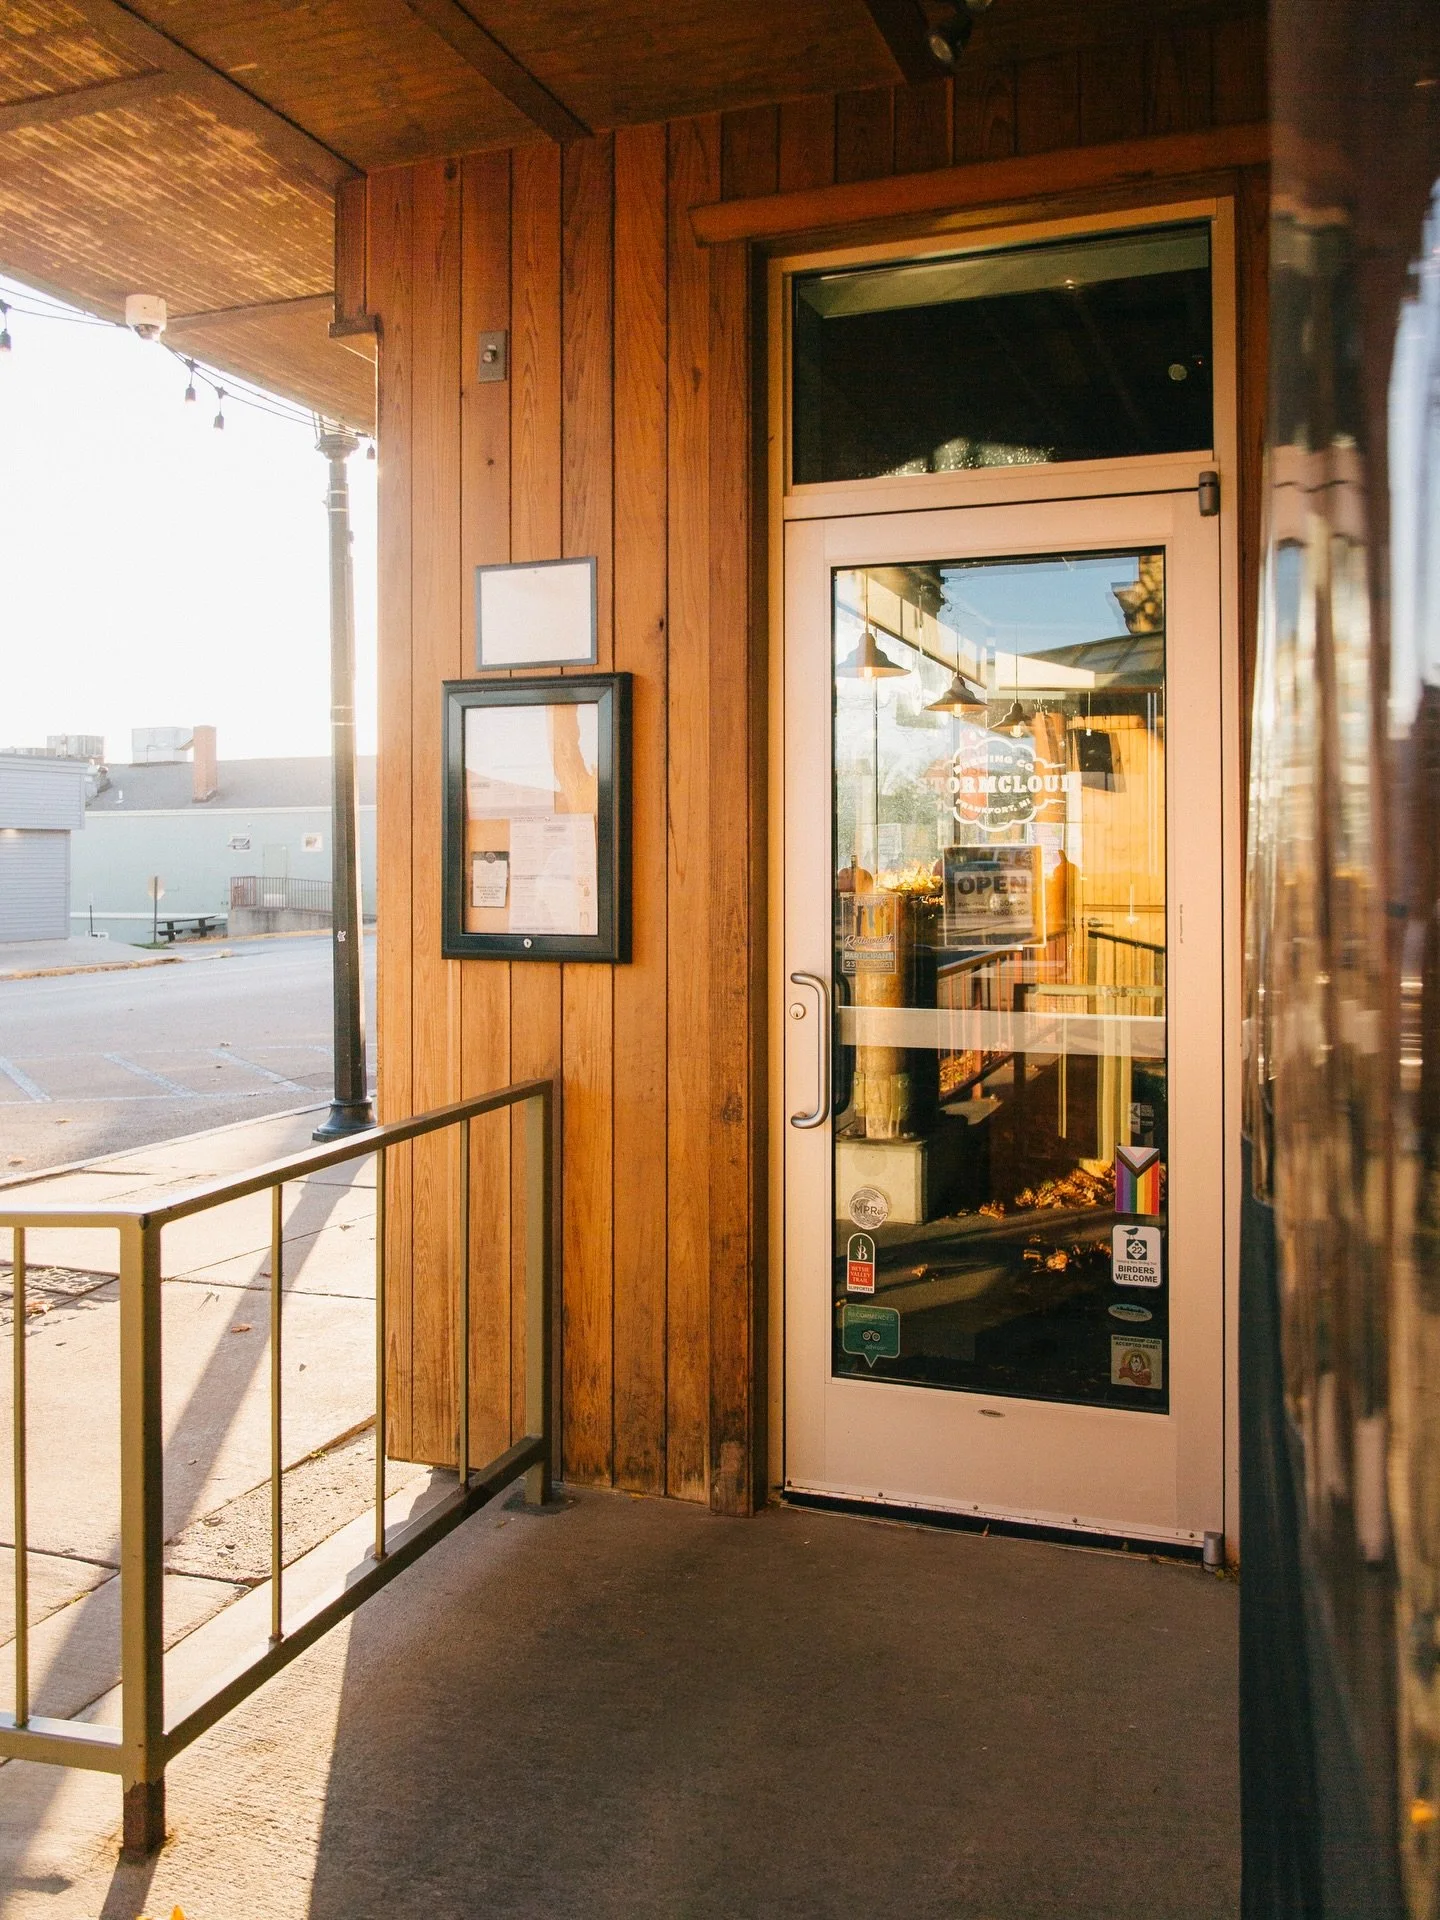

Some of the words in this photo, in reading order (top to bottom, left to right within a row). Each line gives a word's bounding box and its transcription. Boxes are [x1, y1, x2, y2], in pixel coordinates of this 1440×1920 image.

[957, 875, 1027, 895] OPEN
[1131, 1246, 1143, 1255] 22
[1118, 1265, 1155, 1275] BIRDERS
[1115, 1273, 1158, 1283] WELCOME
